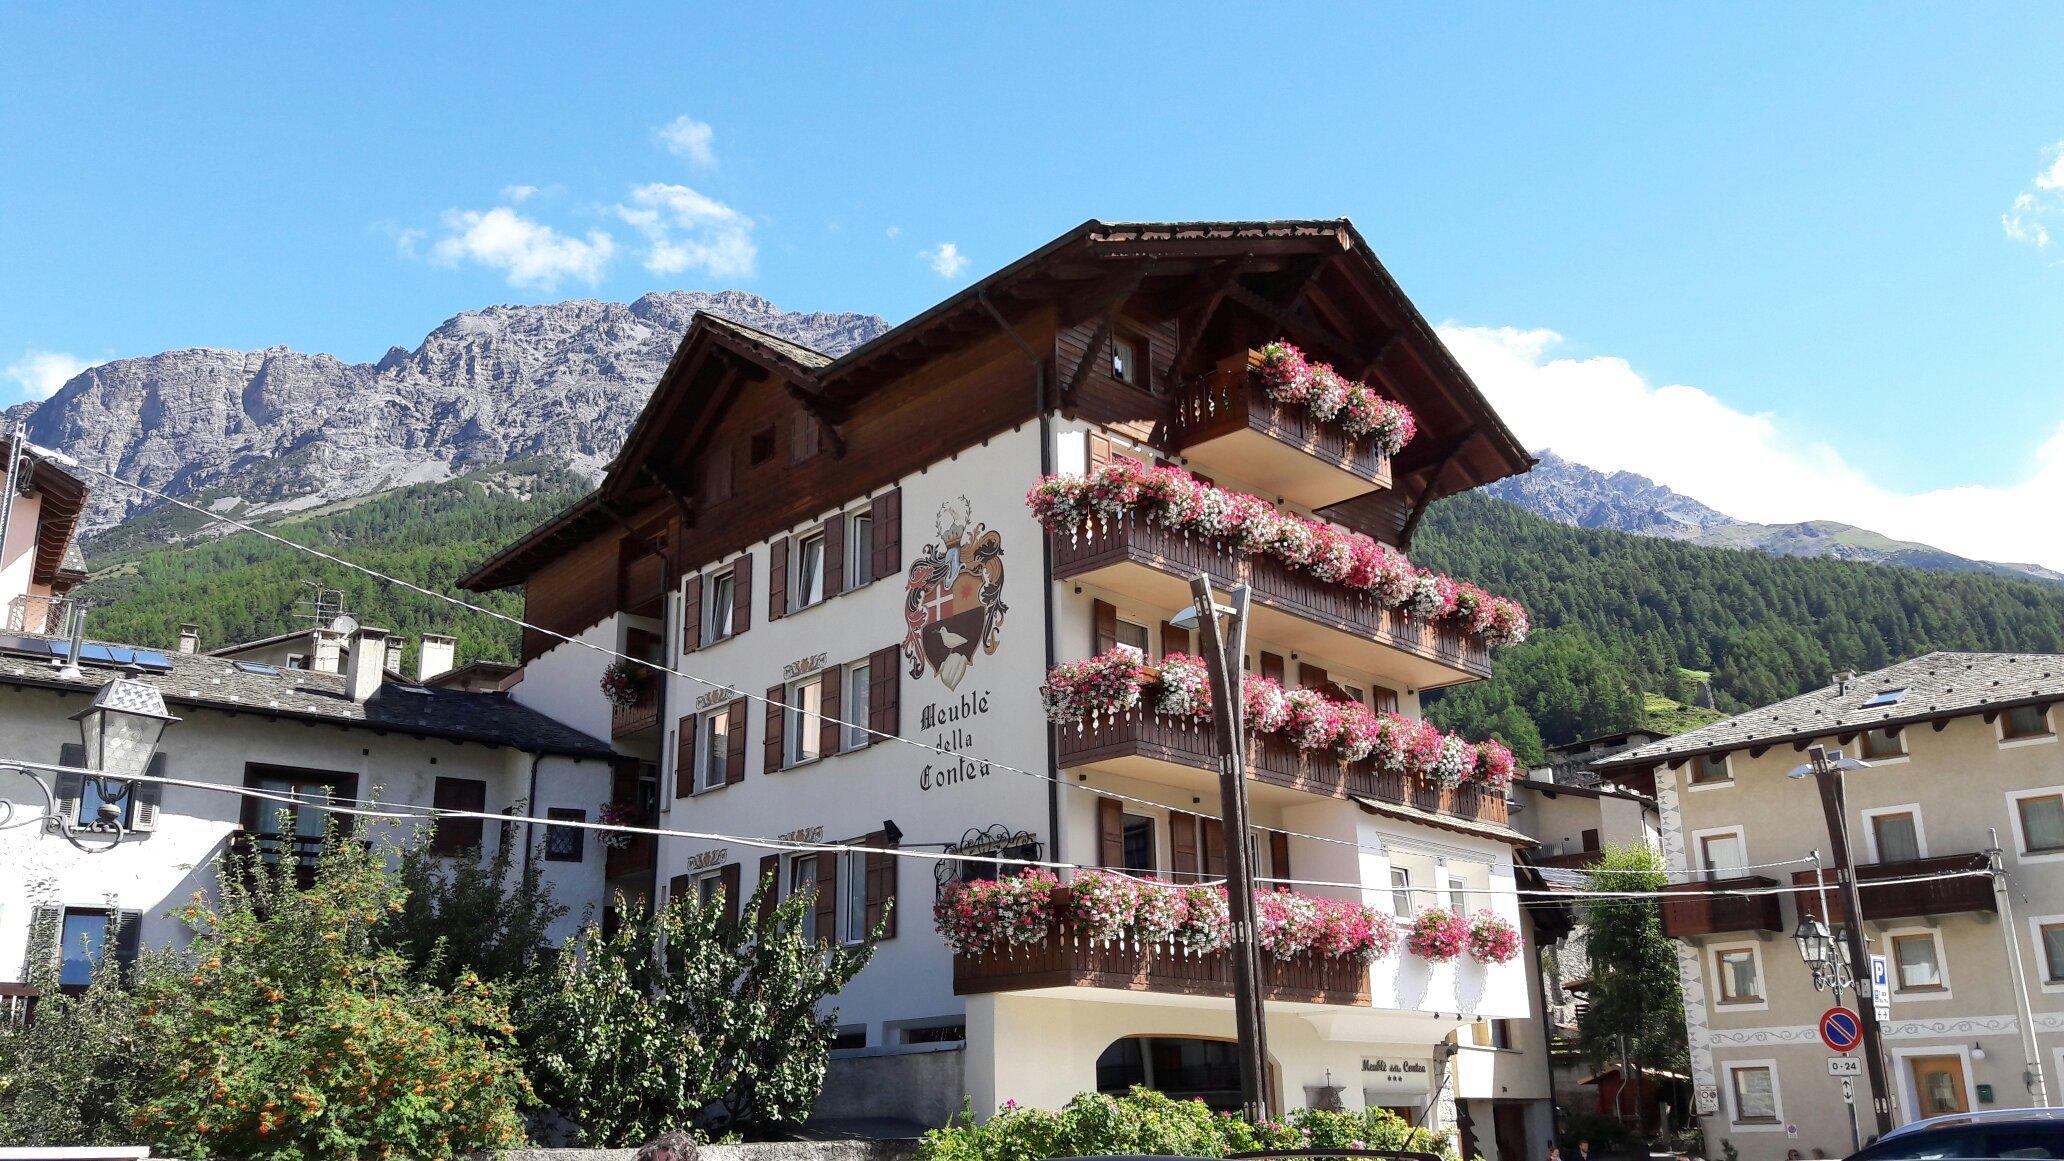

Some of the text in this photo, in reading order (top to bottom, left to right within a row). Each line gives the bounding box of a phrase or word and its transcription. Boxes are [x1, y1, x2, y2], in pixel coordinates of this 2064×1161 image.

[936, 728, 973, 755] della
[920, 756, 990, 791] Contea
[1875, 961, 1884, 983] P
[1402, 1060, 1426, 1073] Contea
